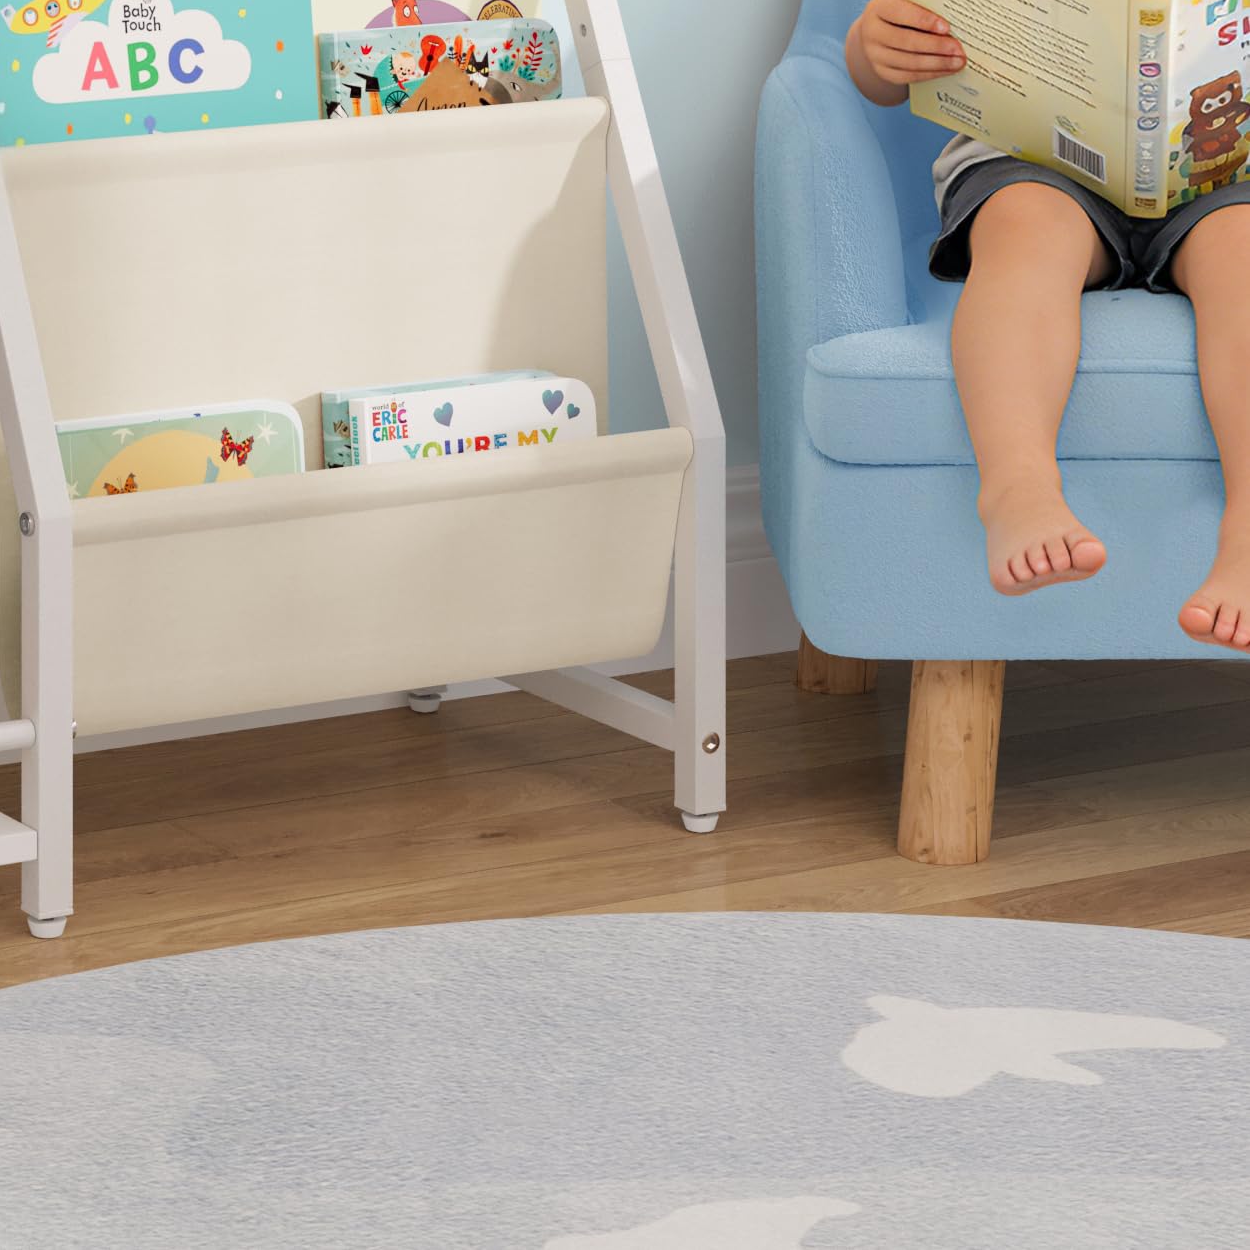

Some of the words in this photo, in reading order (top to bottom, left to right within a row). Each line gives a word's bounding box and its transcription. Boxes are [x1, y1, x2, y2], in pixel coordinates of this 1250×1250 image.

[123, 3, 156, 20] Baby
[122, 19, 161, 34] Touch
[372, 424, 409, 442] CARLE
[403, 433, 508, 460] YOU'RE
[518, 427, 558, 447] MY
